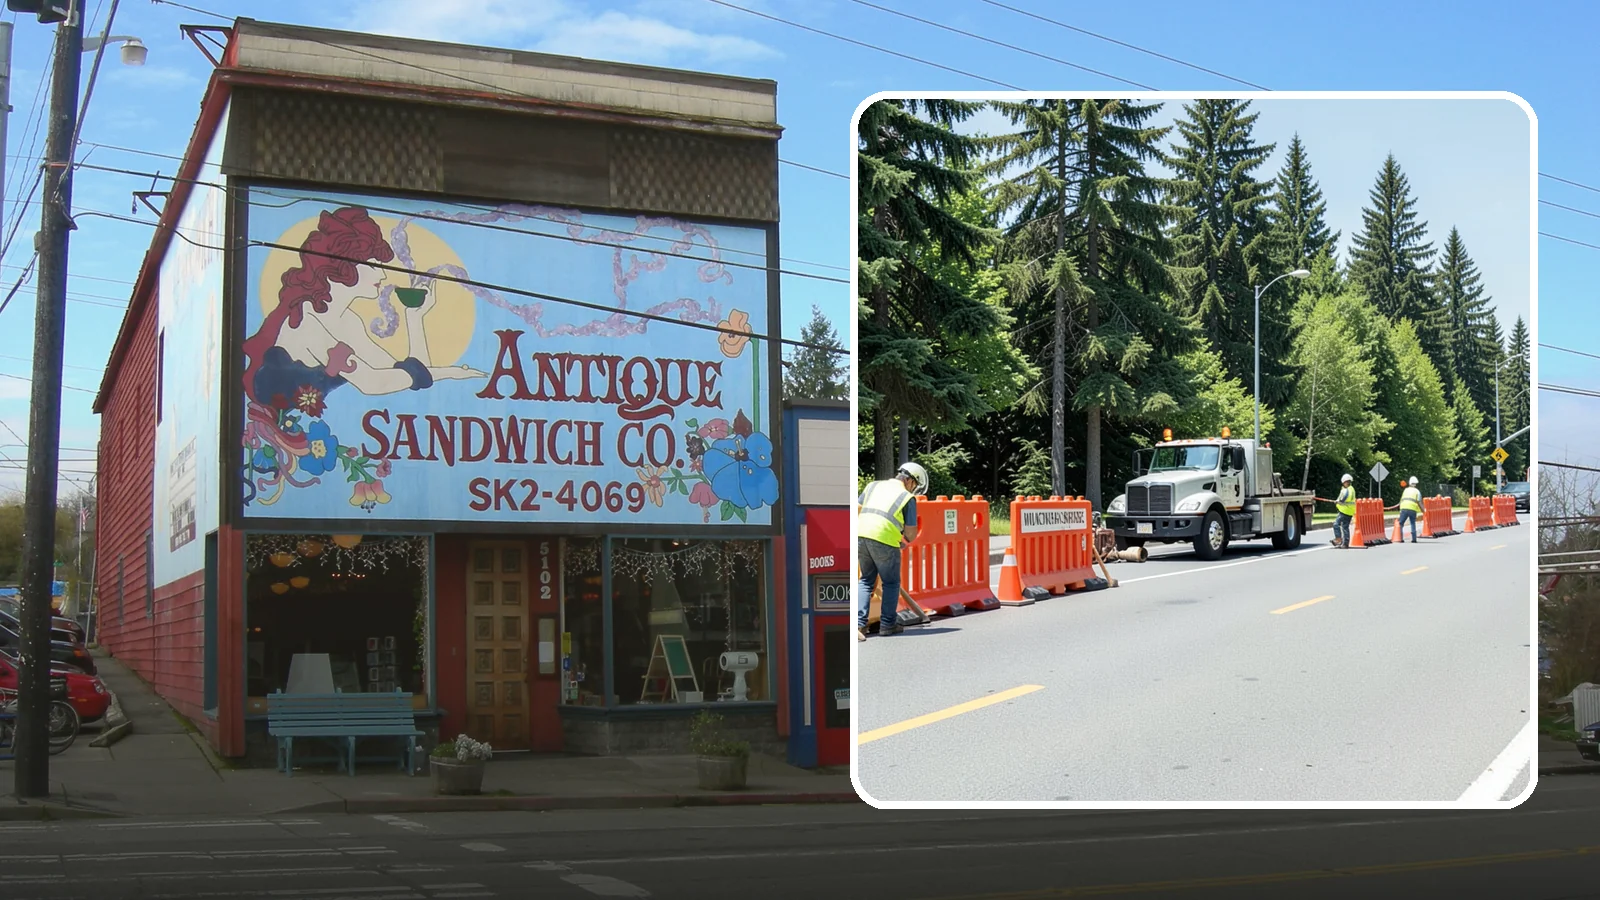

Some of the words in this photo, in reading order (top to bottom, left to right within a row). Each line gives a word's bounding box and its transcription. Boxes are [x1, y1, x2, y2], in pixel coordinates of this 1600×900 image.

[476, 329, 723, 420] ANTIQUE
[361, 409, 604, 467] SANDWICH
[616, 421, 684, 468] CO.
[468, 477, 645, 512] SK2-4069
[540, 542, 551, 600] 5102
[809, 555, 835, 569] BOOKS
